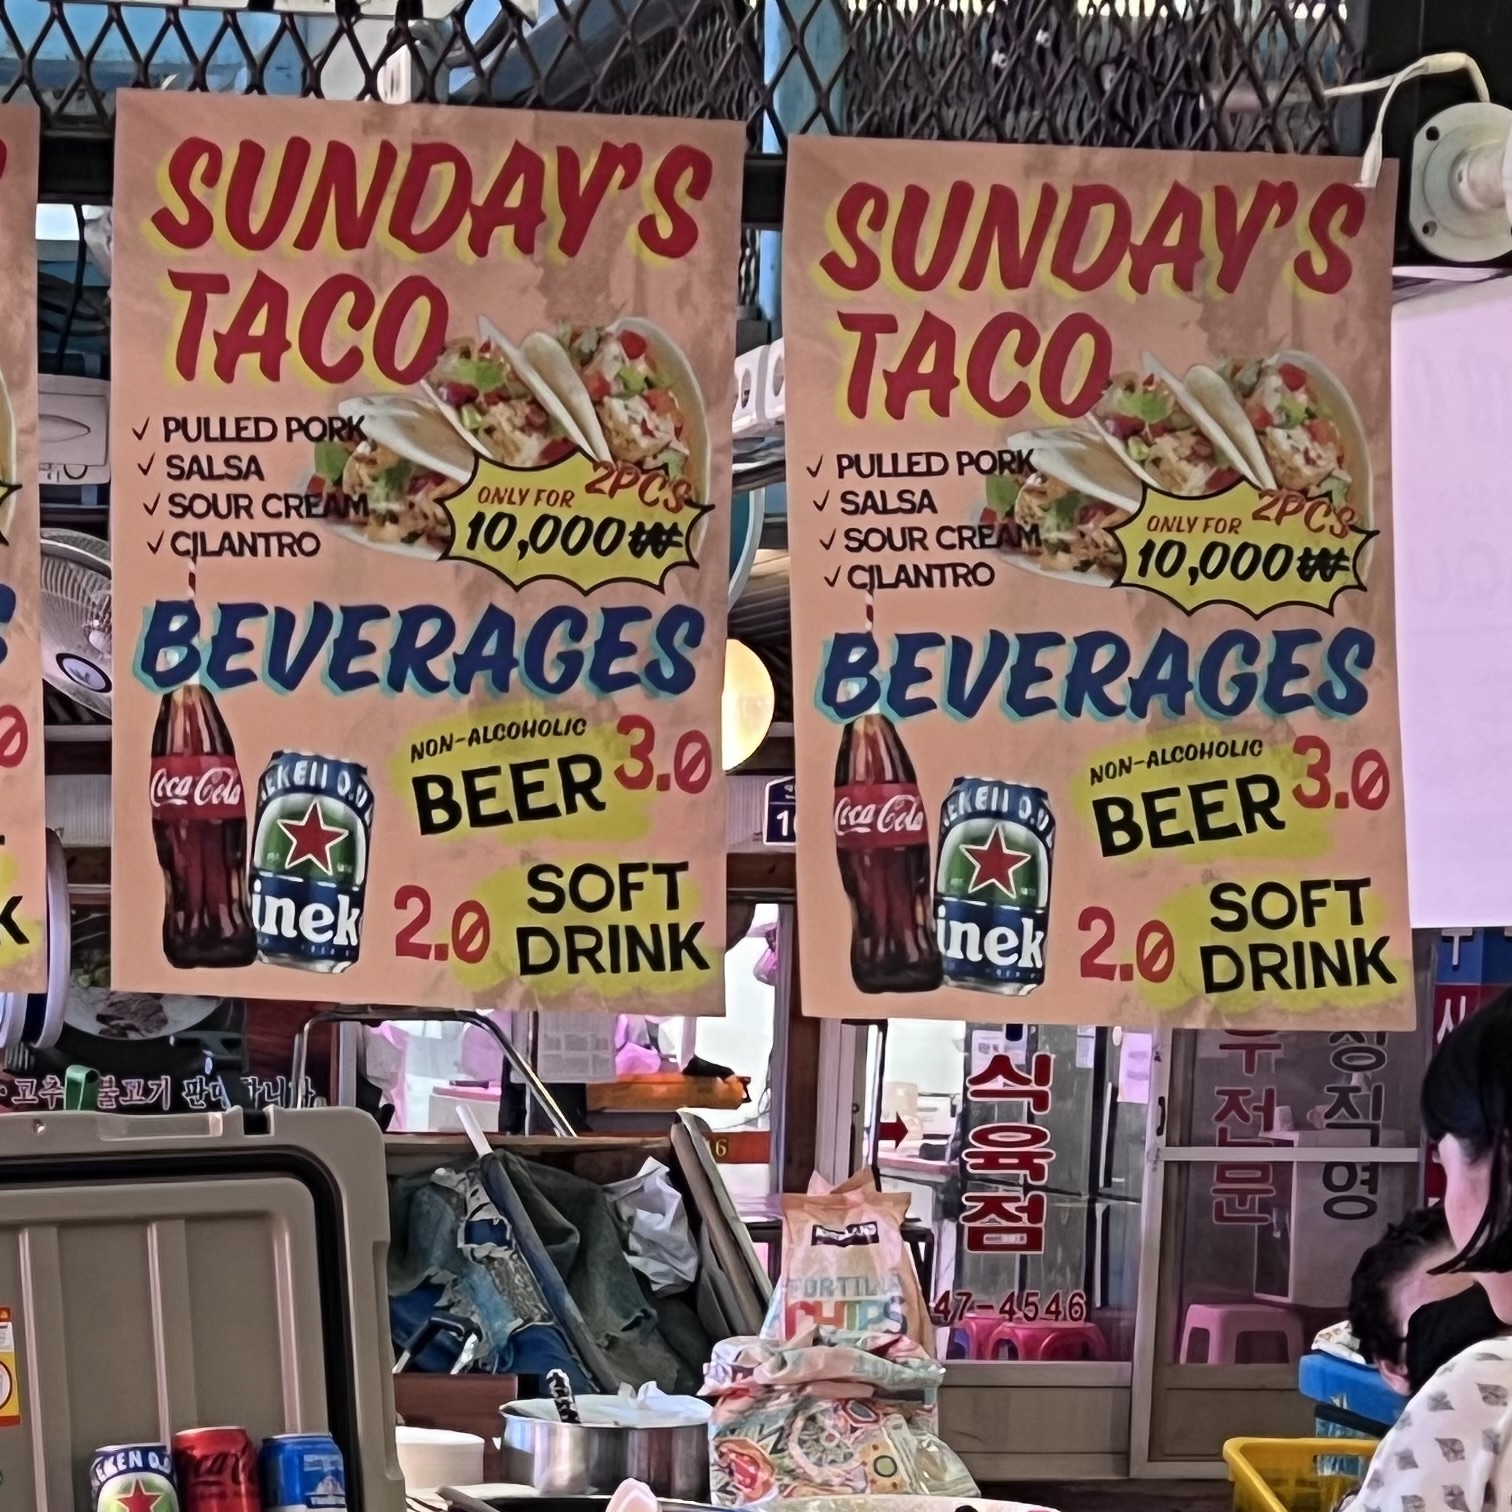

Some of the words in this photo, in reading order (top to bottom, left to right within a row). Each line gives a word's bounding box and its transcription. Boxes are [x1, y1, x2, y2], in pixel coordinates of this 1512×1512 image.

[144, 135, 713, 262] SUNDAY'S
[817, 179, 1366, 298] SUNDAY'S
[167, 268, 449, 386] TACO
[837, 310, 1114, 421] TACO
[163, 415, 278, 443] PULLED
[285, 414, 368, 443] PORK
[166, 454, 265, 481] SALSA
[477, 485, 529, 507] ONLY
[533, 487, 575, 509] FOR
[584, 461, 693, 513] 2PCS
[837, 451, 949, 480] PULLED
[956, 449, 1036, 476] PORK
[168, 493, 254, 519] SOUR
[261, 492, 369, 519] CREAM
[840, 489, 938, 516] SALSA
[1147, 514, 1197, 536] ONLY
[1202, 514, 1242, 536] FOR
[1251, 488, 1360, 540] 2PCS
[170, 530, 322, 559] CILANTRO
[844, 526, 929, 552] SOUR
[936, 524, 1043, 550] CREAM
[847, 562, 996, 592] CILANTRO
[134, 599, 706, 697] BEVERAGES
[817, 627, 1376, 724] BEVERAGES
[409, 717, 588, 763] NON-ALCOHOLIC
[1090, 739, 1263, 786] NON-ALCOHOLIC
[411, 752, 606, 836] BEER
[615, 714, 713, 795] 3.0
[1091, 774, 1286, 858] BEER
[1291, 734, 1390, 812] 3.0
[526, 860, 690, 914] SOFT
[1209, 877, 1371, 932] SOFT
[393, 884, 490, 965] 2.0
[515, 920, 712, 977] DRINK
[1078, 906, 1175, 983] 2.0
[1199, 936, 1397, 994] DRINK
[962, 1051, 1055, 1255] 식육점
